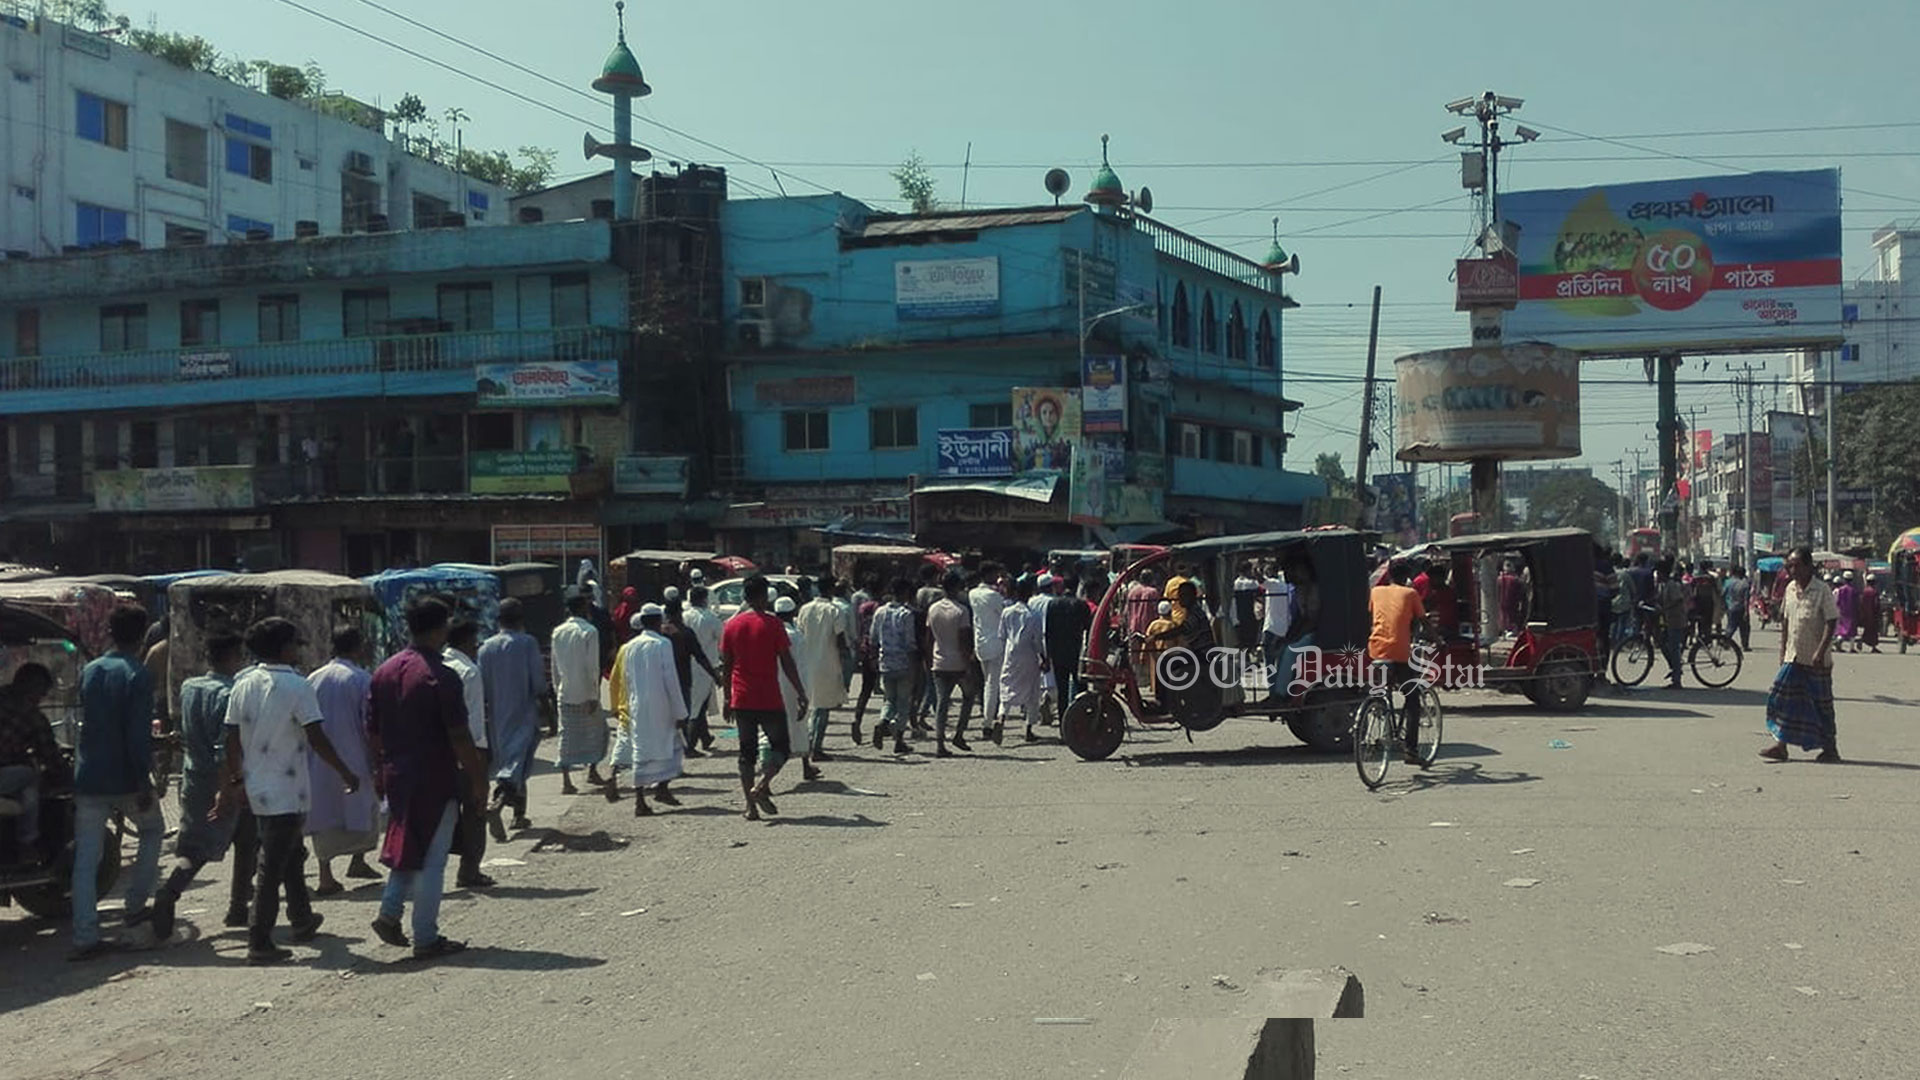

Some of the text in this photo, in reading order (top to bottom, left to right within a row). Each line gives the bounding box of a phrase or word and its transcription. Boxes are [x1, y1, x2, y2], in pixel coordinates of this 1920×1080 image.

[1696, 194, 1774, 218] আলো
[1647, 244, 1695, 272] ৫০
[1557, 264, 1775, 297] প্রতিদিন লাখ পাঠক
[939, 432, 1011, 462] ইউনানী
